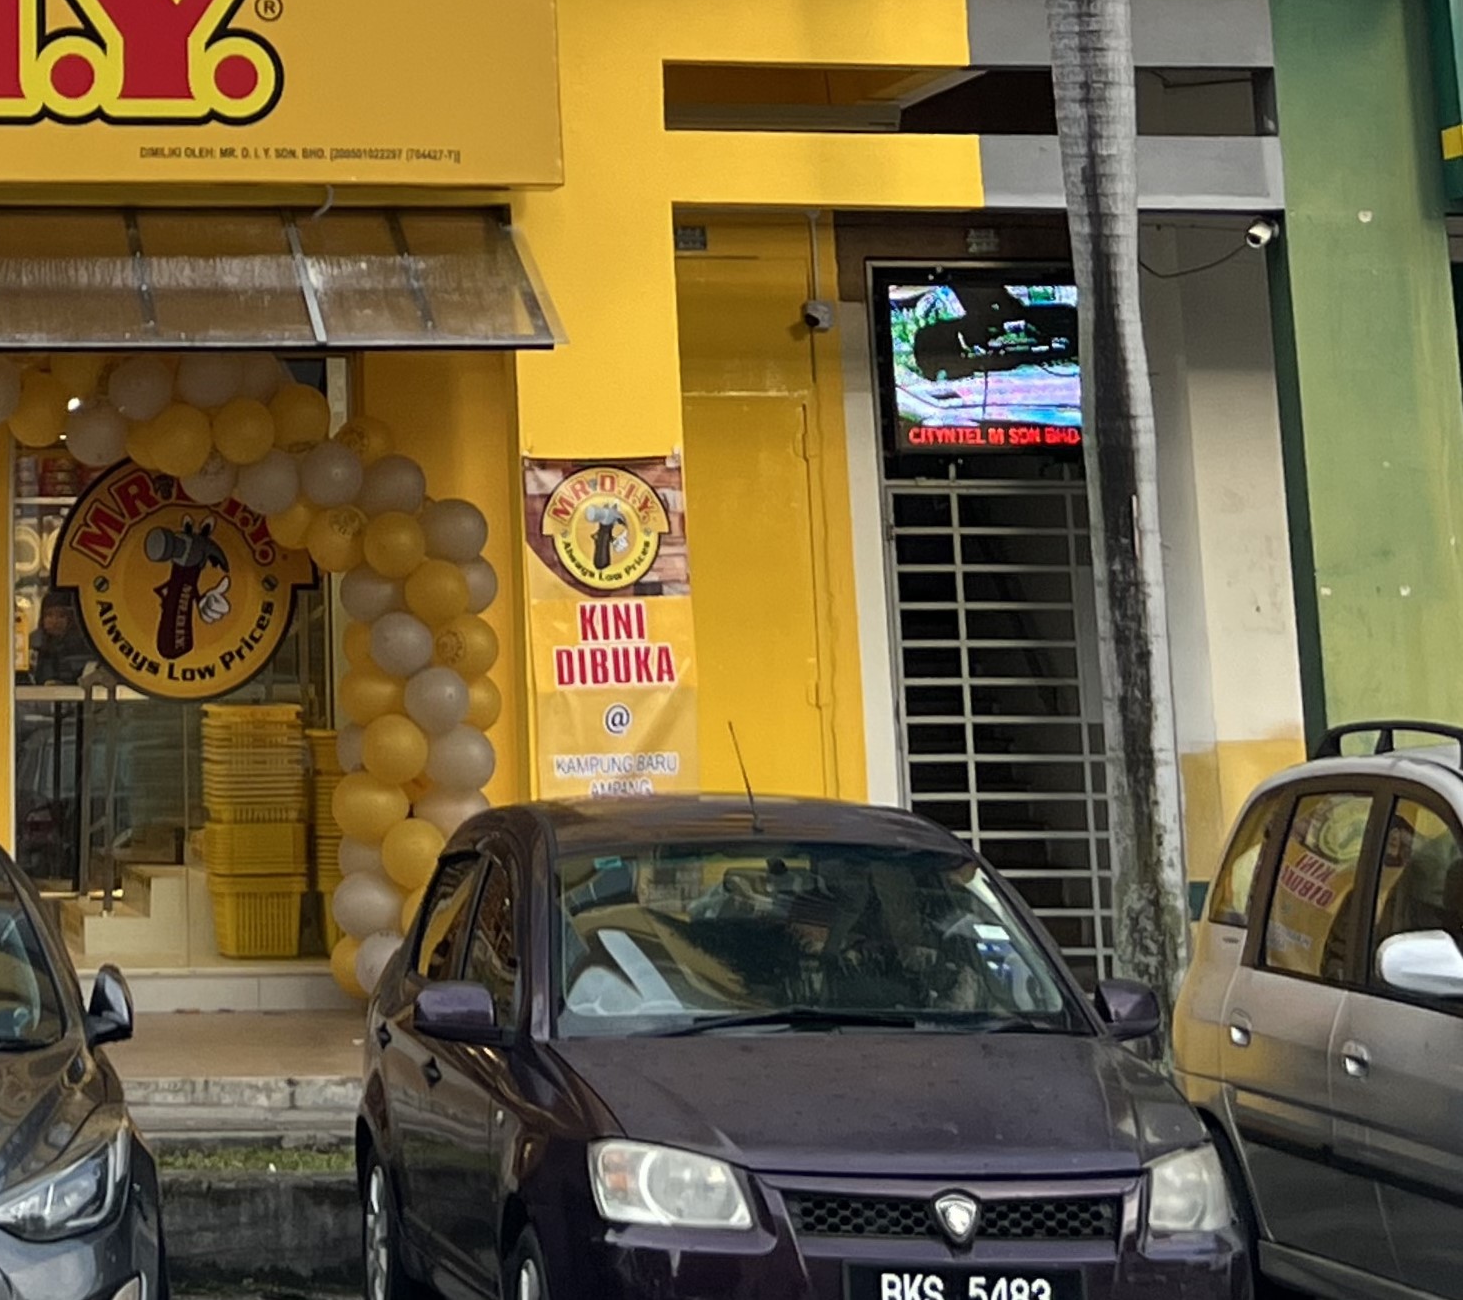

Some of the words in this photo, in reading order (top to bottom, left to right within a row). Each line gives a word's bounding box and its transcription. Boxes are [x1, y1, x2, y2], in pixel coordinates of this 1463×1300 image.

[1008, 427, 1041, 445] SDN
[562, 540, 595, 579] Always
[598, 570, 623, 582] Low
[624, 540, 651, 576] Prices
[579, 602, 646, 641] KINI
[96, 599, 161, 676] Always
[167, 662, 216, 682] Low
[219, 600, 275, 672] Prices
[555, 645, 675, 685] DIBUKA
[605, 704, 631, 734] @
[555, 755, 633, 774] KAMPUNG
[636, 754, 677, 772] BARU
[591, 778, 652, 796] AMPANG
[881, 1272, 945, 1300] BKS
[968, 1275, 1052, 1300] 5483
